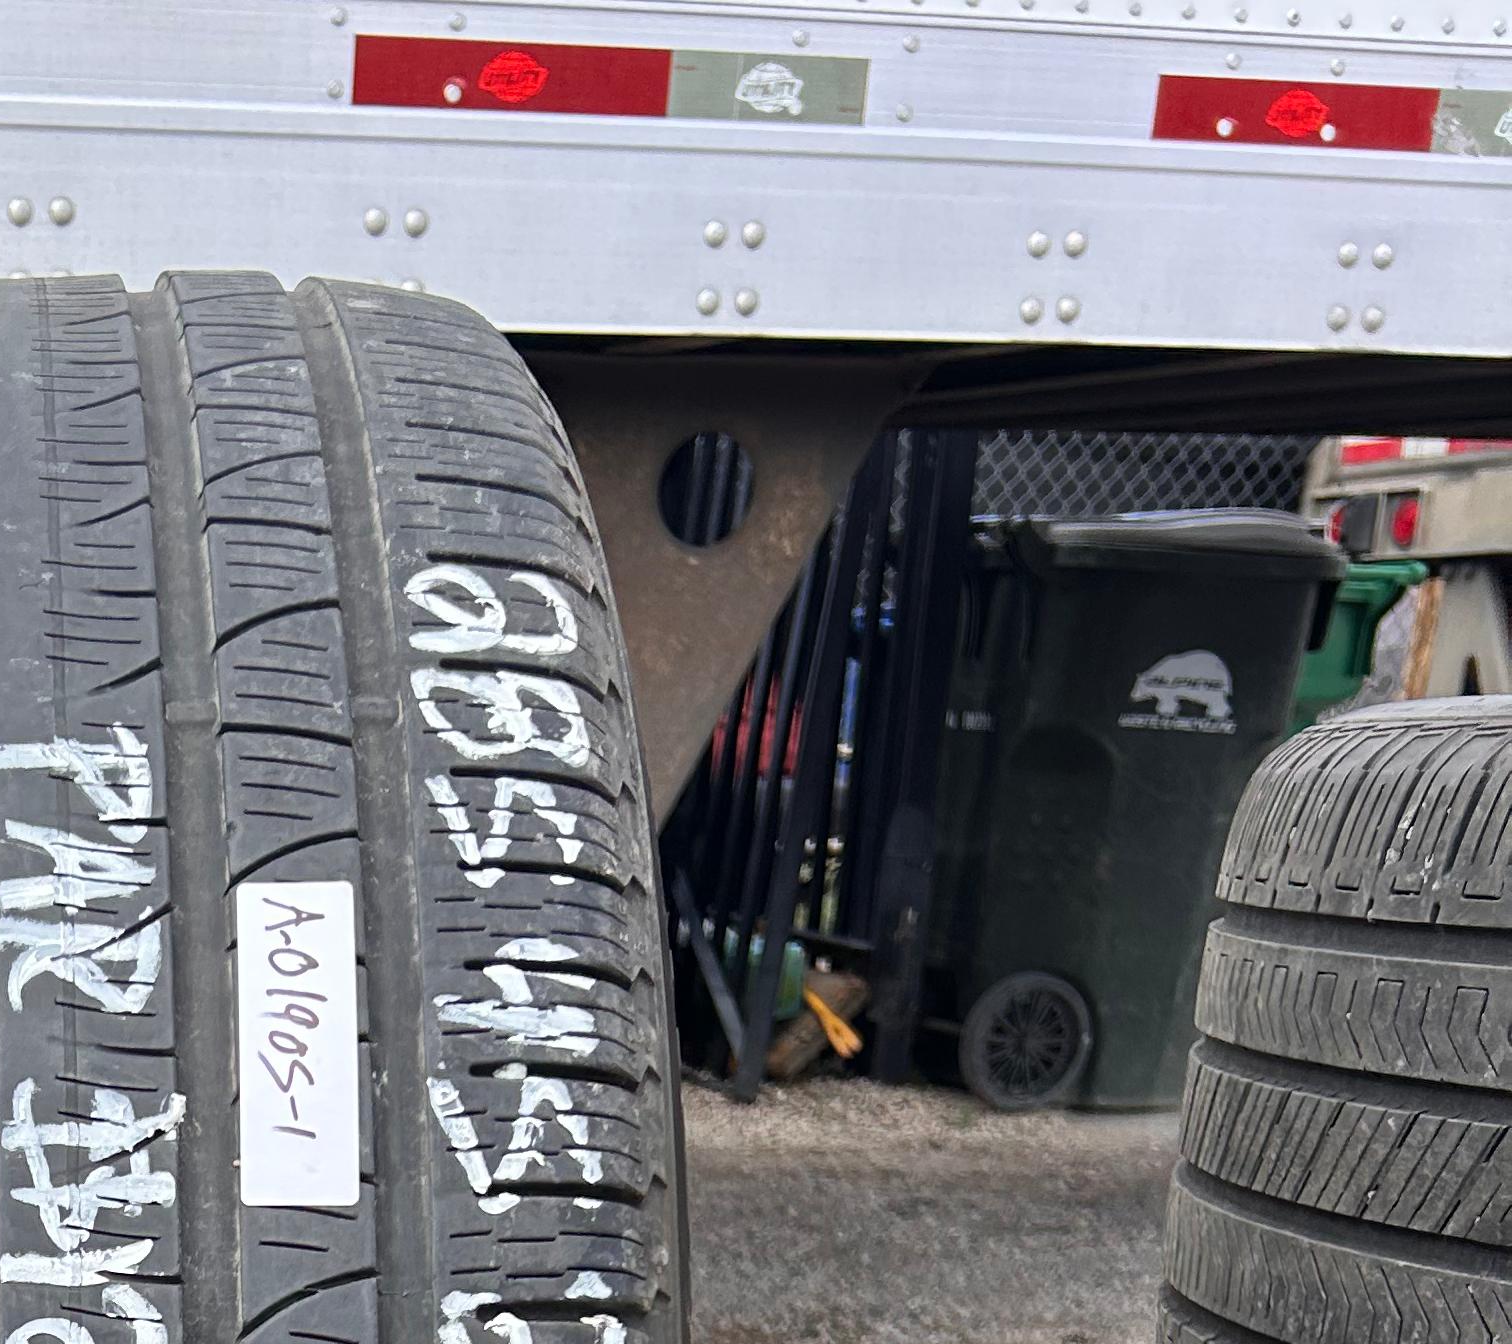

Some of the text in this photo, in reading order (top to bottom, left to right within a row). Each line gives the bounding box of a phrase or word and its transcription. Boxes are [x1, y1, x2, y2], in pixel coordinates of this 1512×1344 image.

[404, 562, 590, 888] 285
[257, 896, 329, 1140] A-01905-1
[426, 936, 602, 1214] 45
